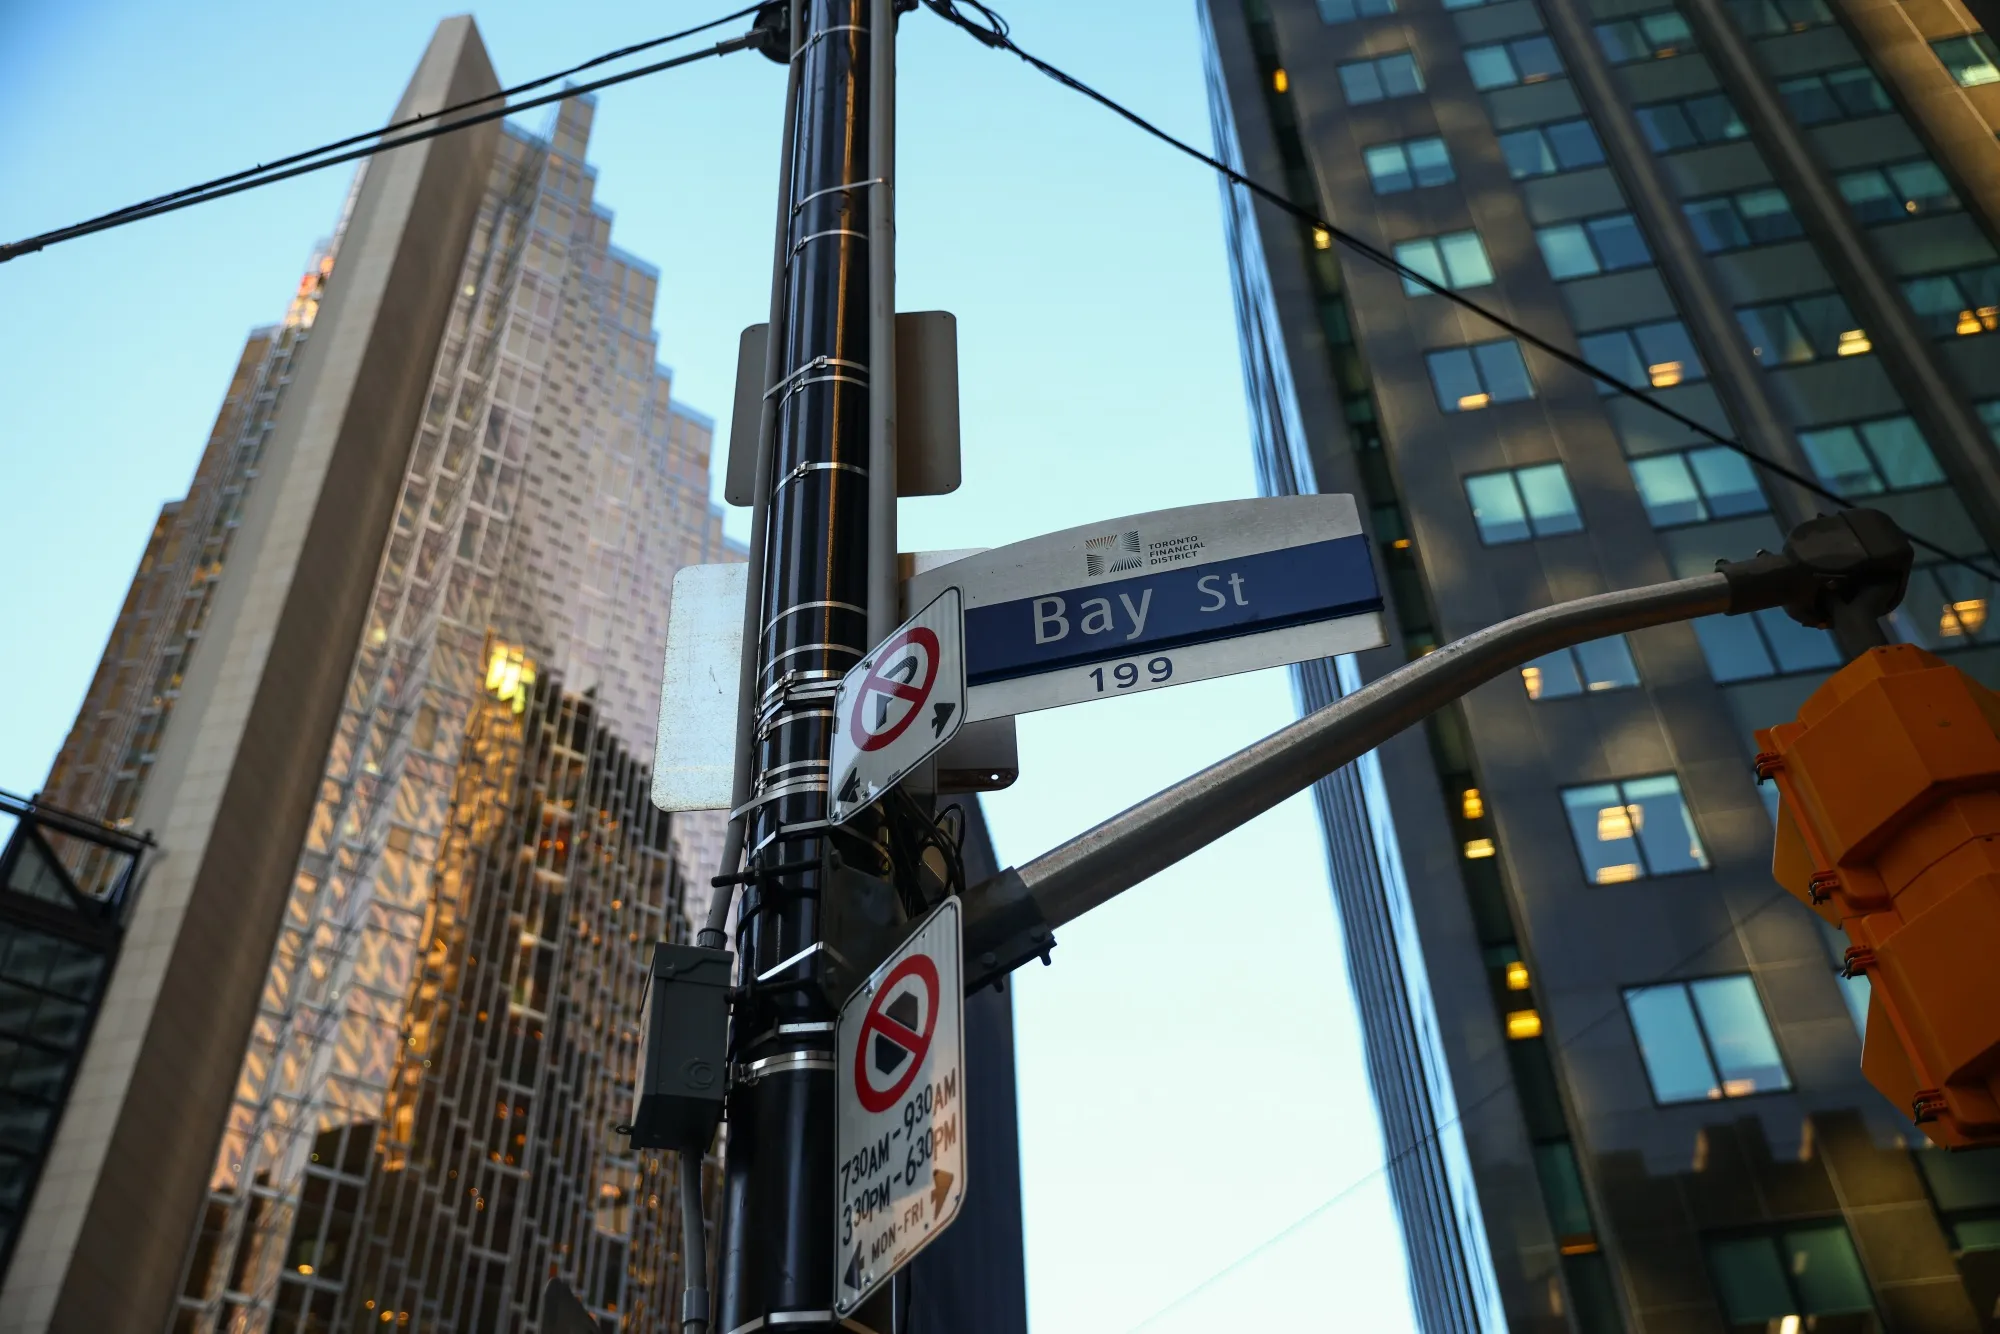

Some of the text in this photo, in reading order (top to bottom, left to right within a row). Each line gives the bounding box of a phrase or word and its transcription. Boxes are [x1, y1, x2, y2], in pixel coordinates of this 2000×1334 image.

[1148, 535, 1198, 550] TORONTO
[1149, 541, 1206, 558] FINANCIAL
[1150, 550, 1198, 565] DISTRICT
[1032, 572, 1249, 645] Bay St
[1089, 656, 1174, 693] 199
